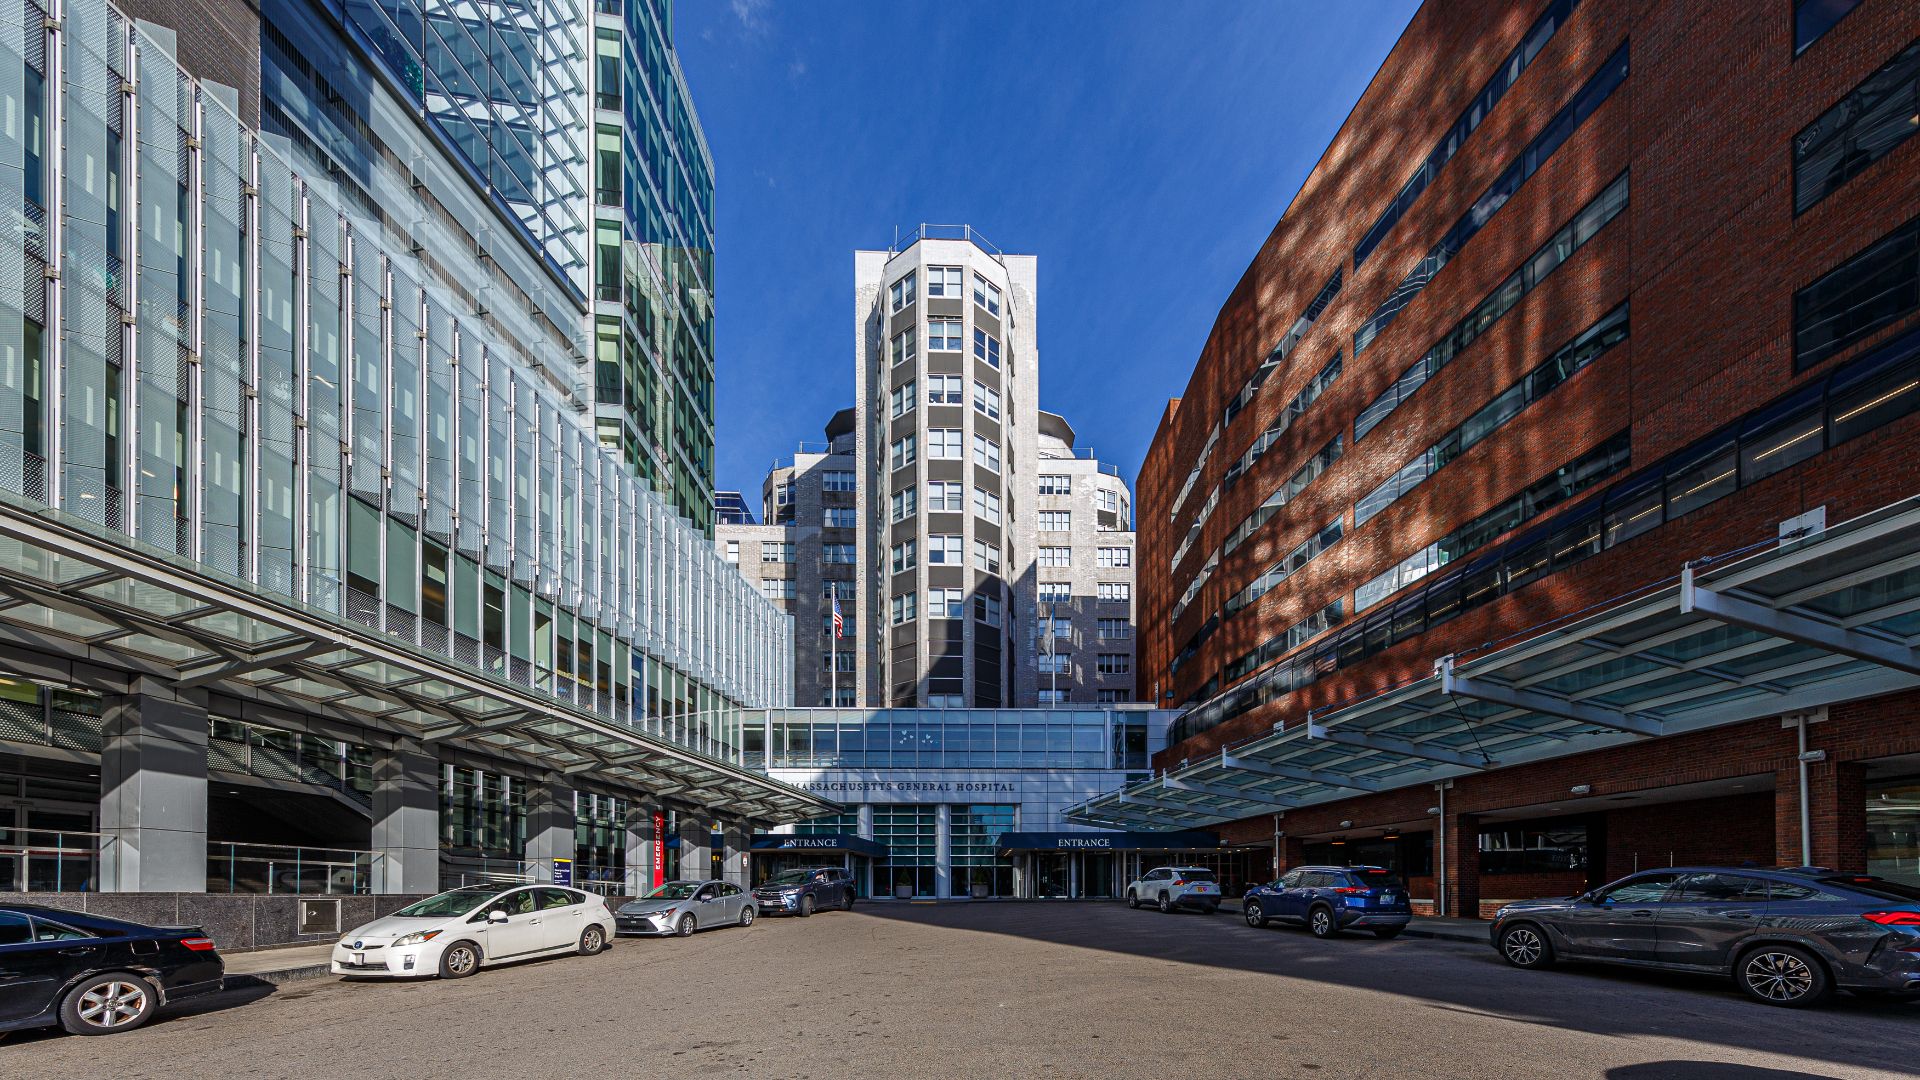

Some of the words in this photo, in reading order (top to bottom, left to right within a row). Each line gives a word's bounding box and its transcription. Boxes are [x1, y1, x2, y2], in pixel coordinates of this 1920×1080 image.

[790, 782, 892, 791] MASSACHUSETTS
[897, 782, 952, 791] GENERAL
[956, 783, 1015, 792] HOSPITAL
[784, 838, 838, 847] ENTRANCE
[1058, 838, 1110, 847] ENTRANCE
